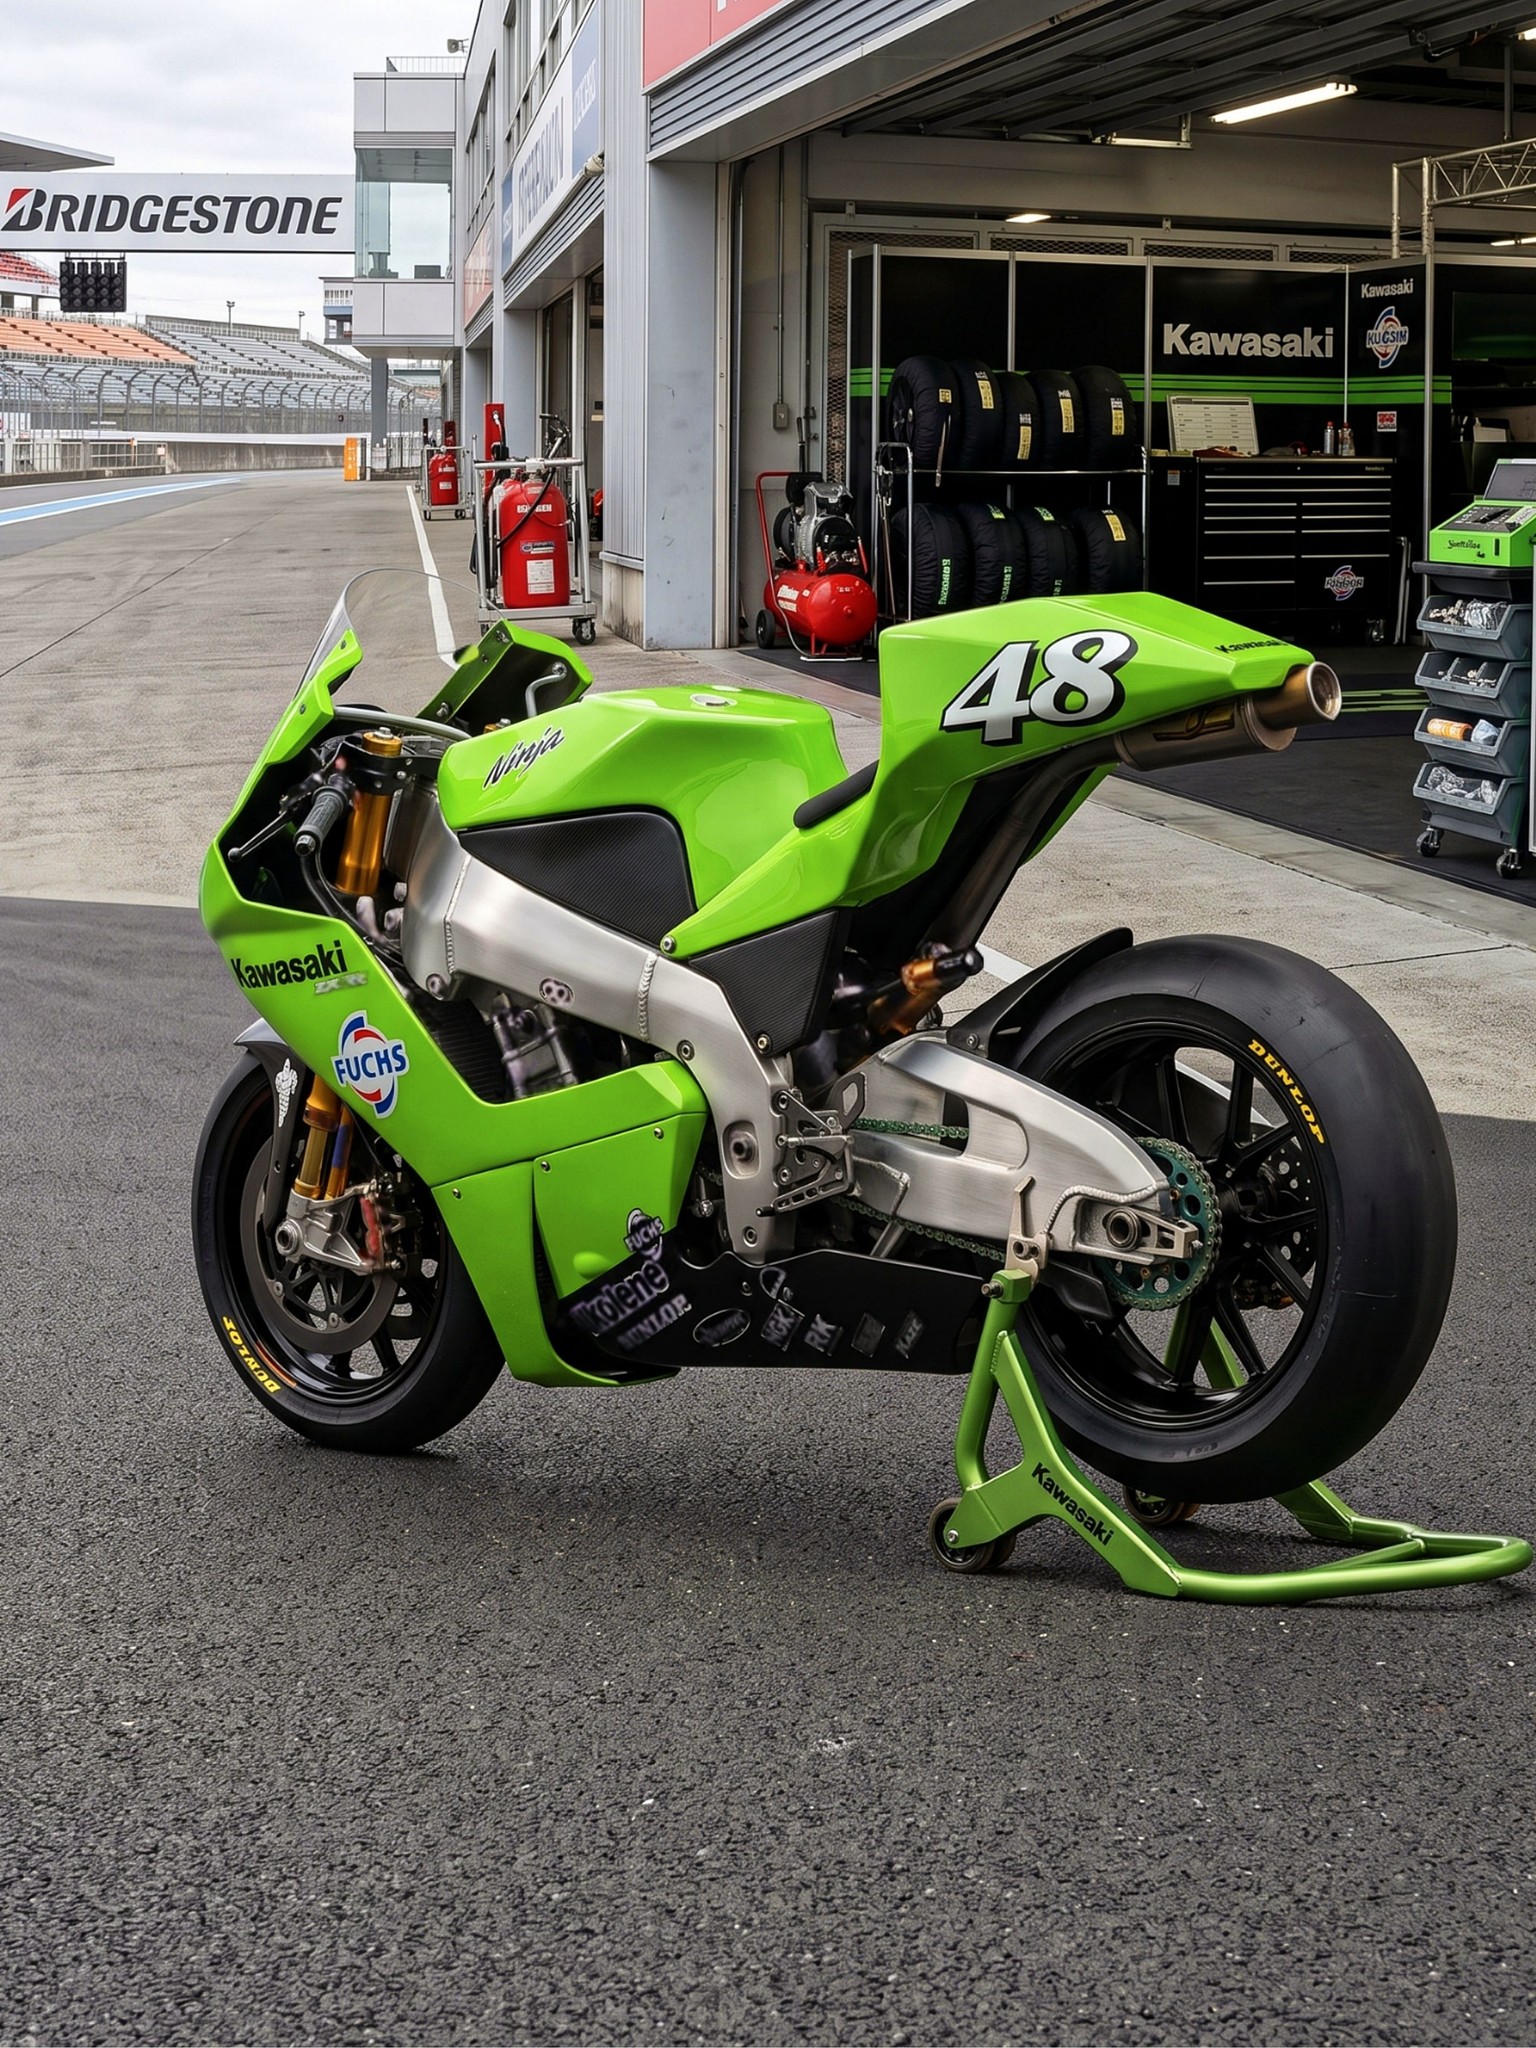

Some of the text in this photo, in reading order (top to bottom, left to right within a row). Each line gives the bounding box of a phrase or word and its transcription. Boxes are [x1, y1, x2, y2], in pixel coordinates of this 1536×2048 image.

[0, 188, 343, 235] BRIDGESTONE
[1361, 278, 1415, 299] Kawasaki
[1163, 323, 1334, 358] Kawasaki
[940, 629, 1138, 745] 48
[482, 726, 565, 790] Ninja
[230, 939, 348, 990] Kawasaki
[333, 1043, 407, 1085] FUCHS
[1247, 1038, 1325, 1144] DUNLOP
[624, 1216, 664, 1251] FUCHS
[222, 1315, 282, 1394] DUNLOP
[1031, 1461, 1115, 1547] Kawasaki
